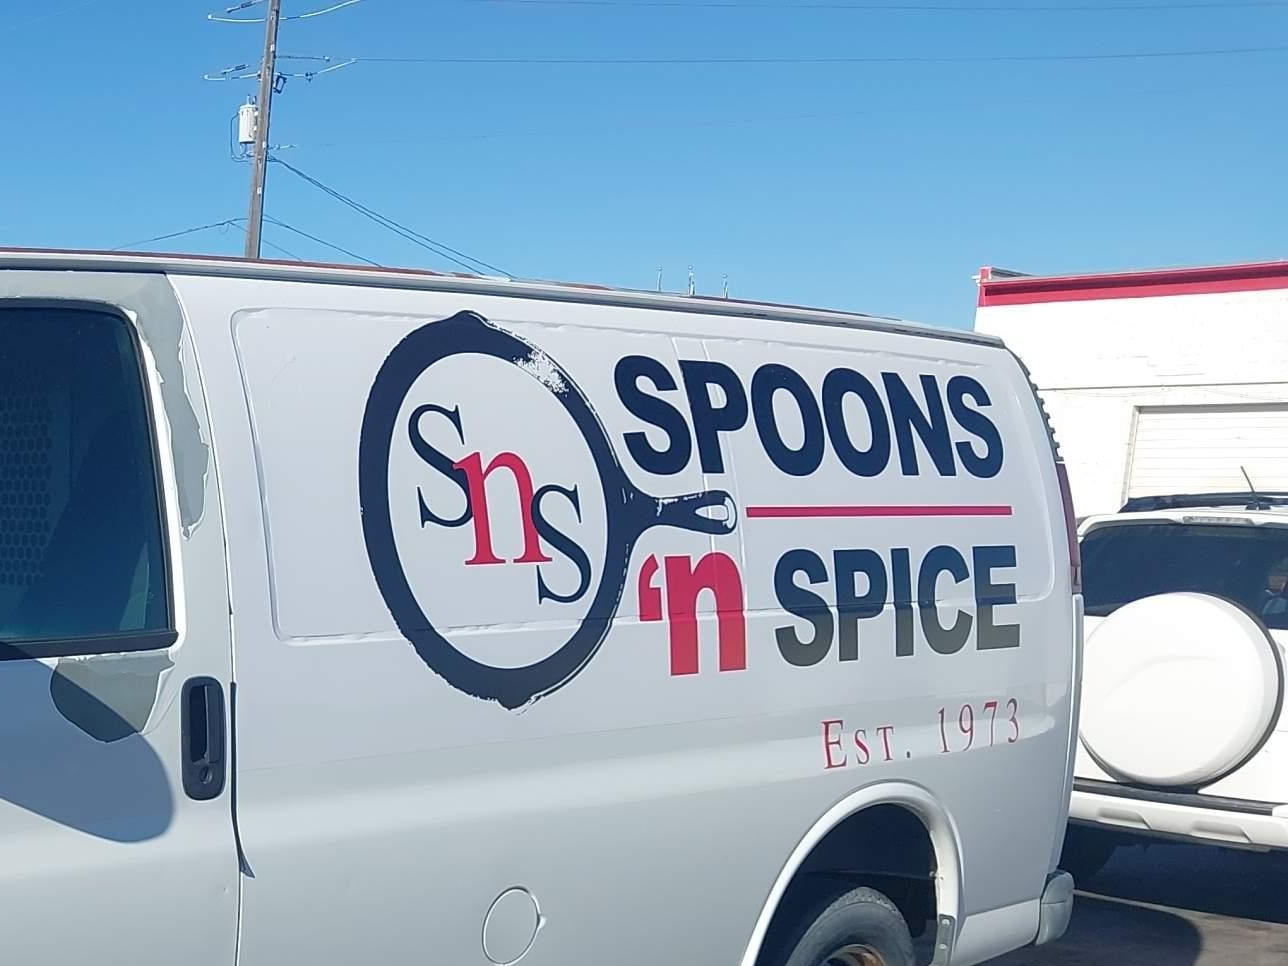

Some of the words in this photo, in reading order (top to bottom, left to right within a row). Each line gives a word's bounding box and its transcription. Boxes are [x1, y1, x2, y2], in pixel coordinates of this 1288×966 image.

[614, 355, 1004, 479] SPOONS
[408, 404, 591, 605] SnS
[774, 545, 1021, 667] SPICE
[938, 698, 1019, 753] 1973
